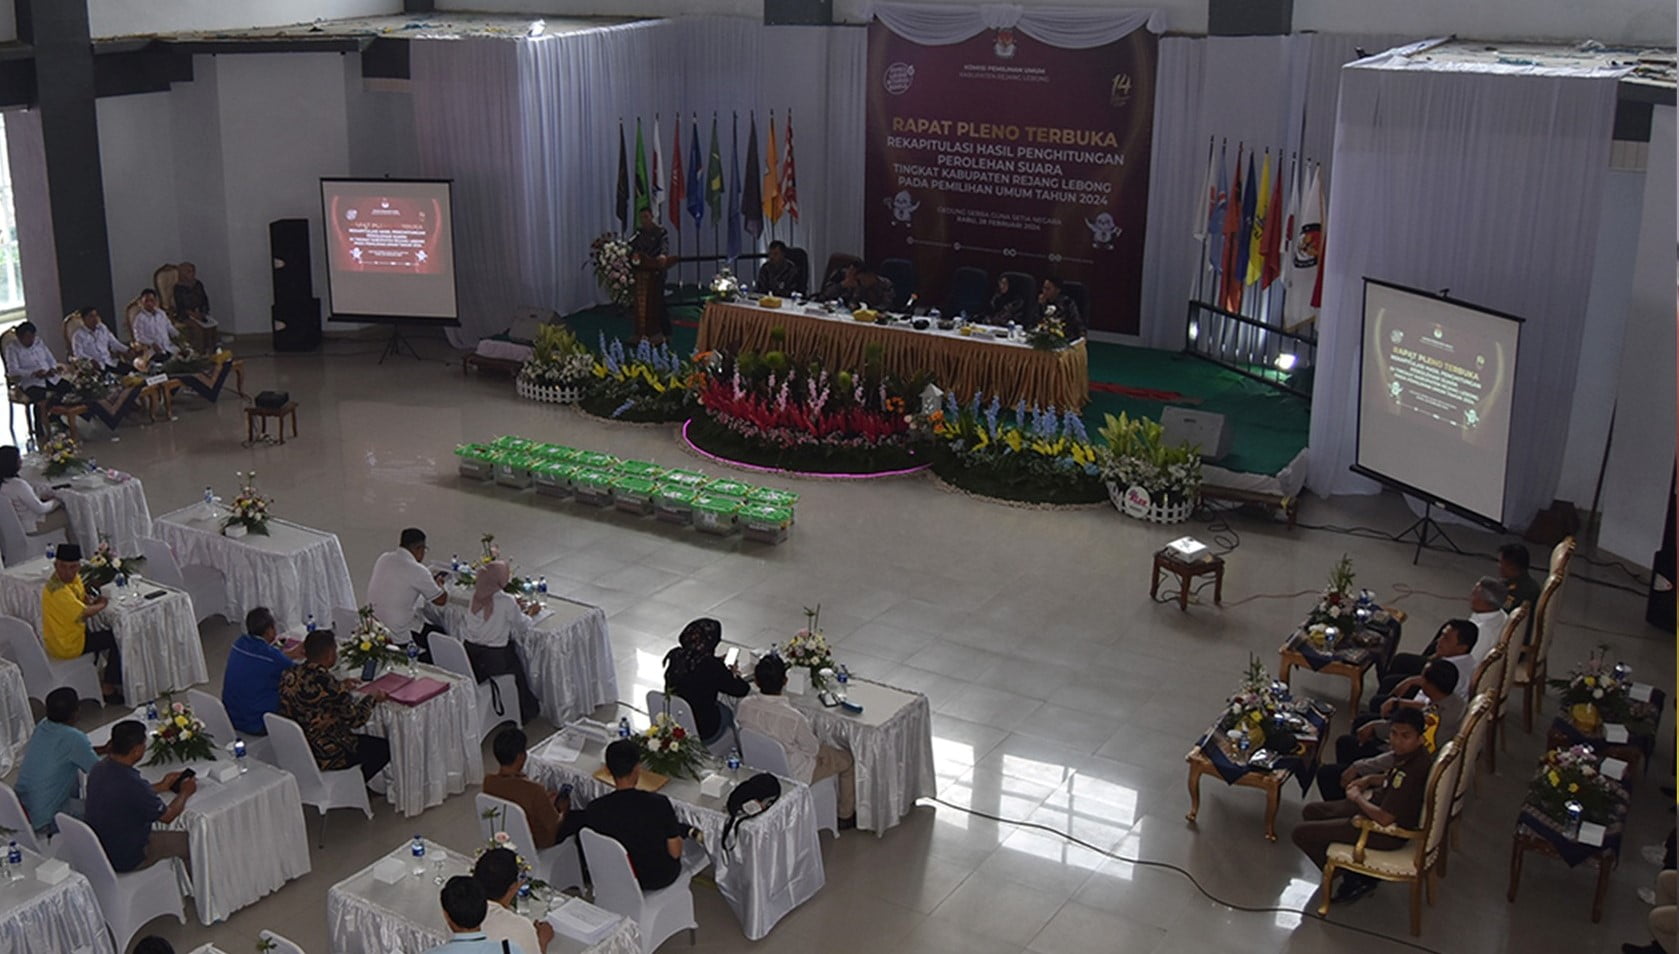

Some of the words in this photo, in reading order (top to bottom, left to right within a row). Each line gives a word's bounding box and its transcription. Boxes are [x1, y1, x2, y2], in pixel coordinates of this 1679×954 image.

[892, 117, 952, 135] RAPAT
[956, 121, 1020, 140] PLENO
[1025, 126, 1117, 147] TERBUKA
[887, 136, 973, 154] REKAPITULASI
[976, 144, 1014, 158] HASIL
[1017, 147, 1124, 166] PENGHITUNGAN
[937, 154, 1014, 171] PEROLEHAN
[1018, 162, 1063, 176] SUARA
[894, 163, 938, 177] TINGKAT
[941, 169, 1010, 185] KABUPATEN
[1013, 175, 1059, 189] REJANG
[1062, 179, 1111, 193] LEBONG
[898, 176, 929, 189] PADA
[931, 180, 993, 195] PEMILIHAN
[995, 186, 1033, 199] UMUM
[1035, 189, 1077, 203] TAHUN
[1079, 193, 1108, 206] 2024
[937, 206, 966, 216] GEDUNG
[967, 208, 989, 217] SERBA
[990, 211, 1011, 220] GUNA
[1012, 213, 1030, 222] SETIA
[1032, 216, 1062, 225] NEGARA
[988, 219, 1022, 229] FEBRUARI
